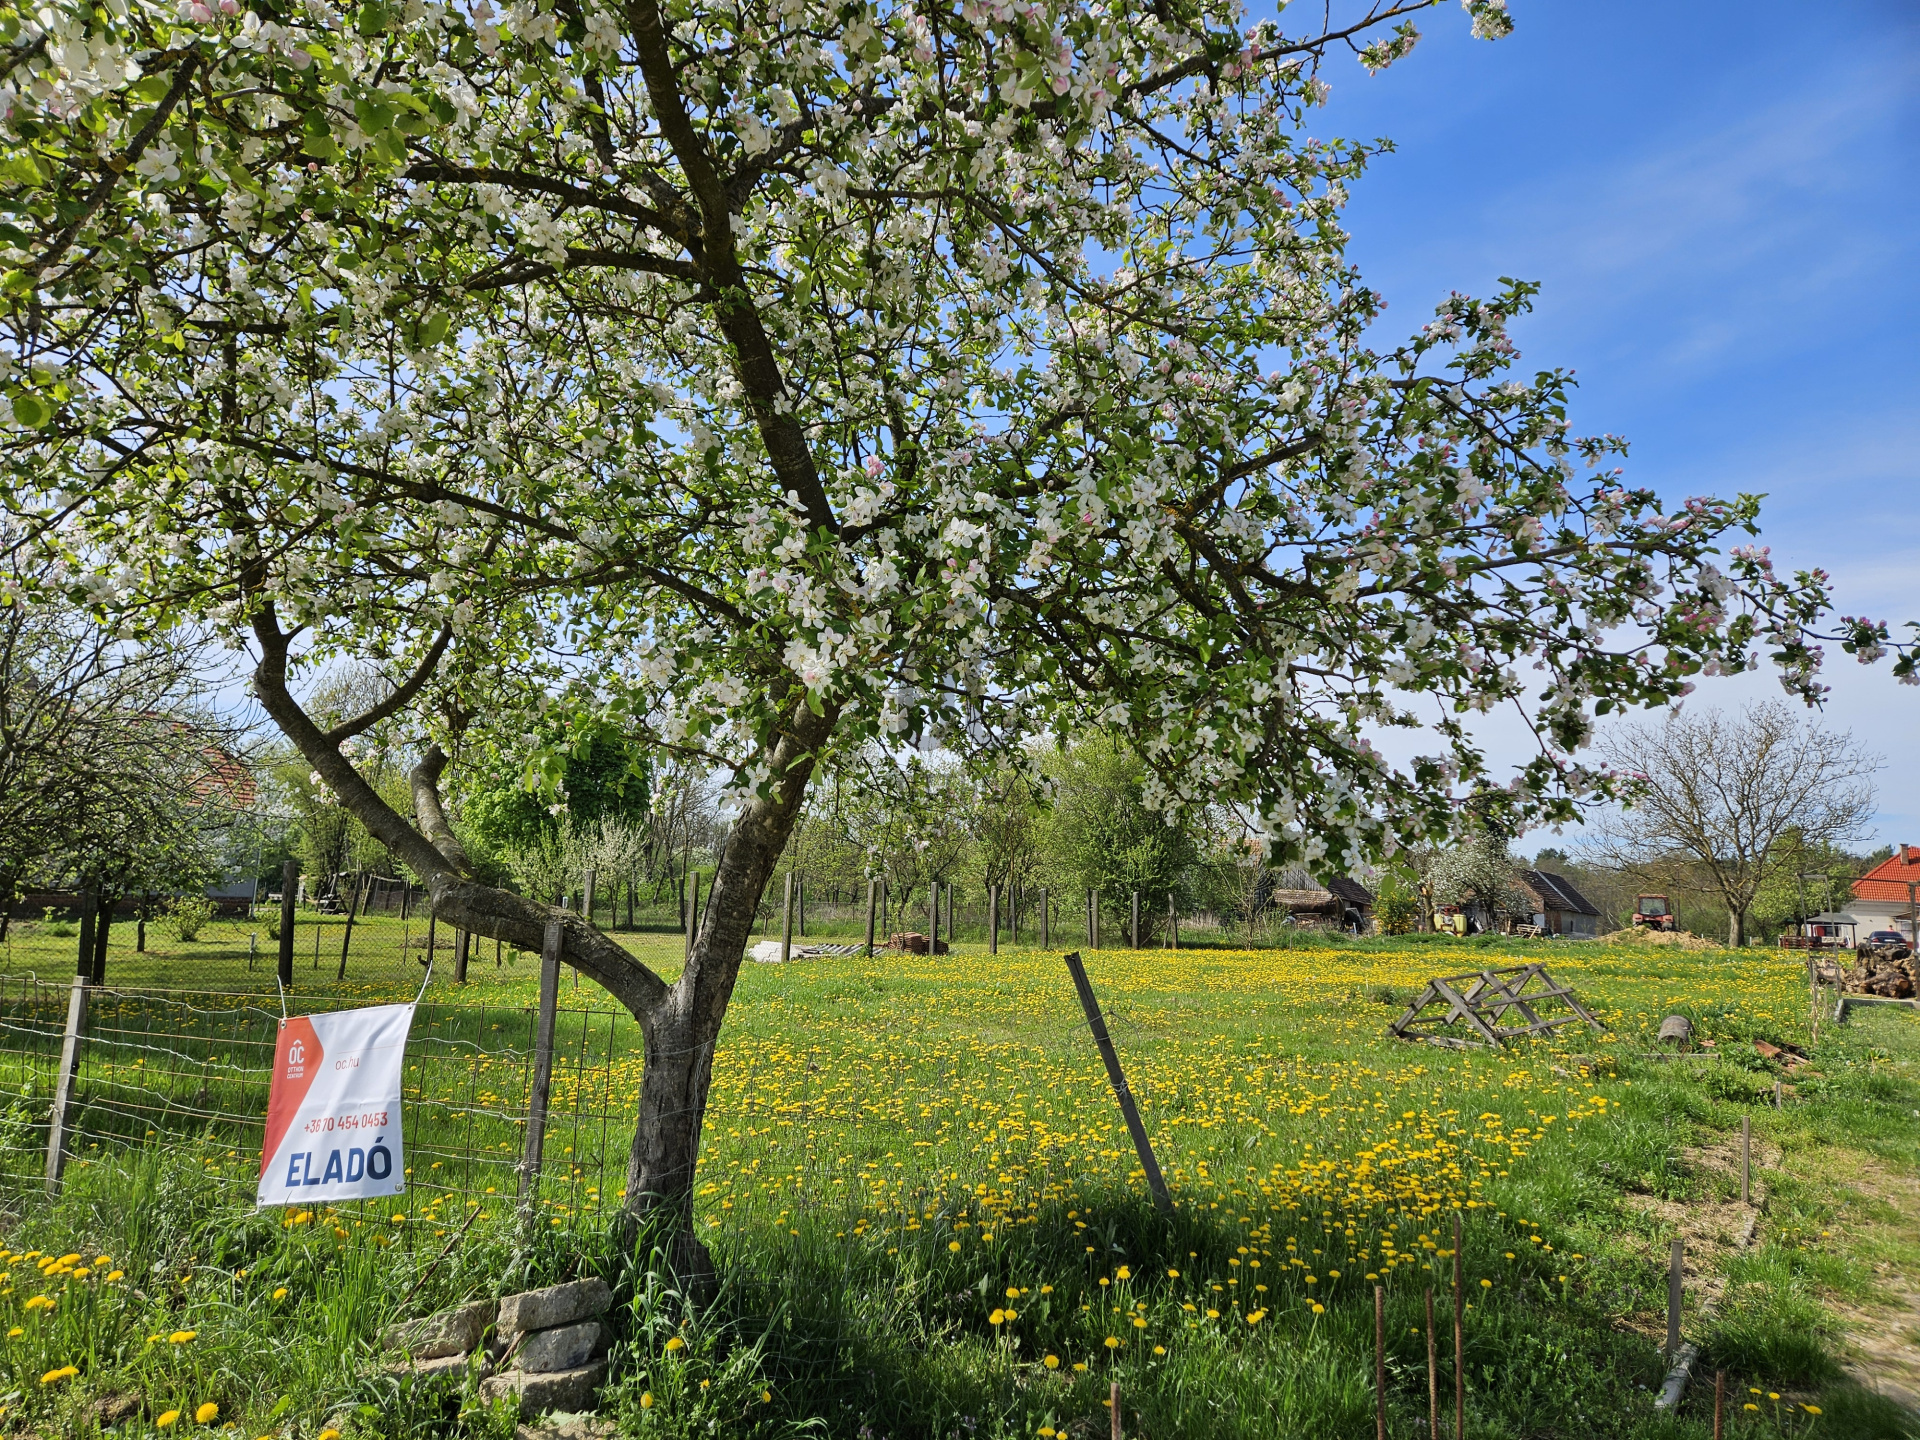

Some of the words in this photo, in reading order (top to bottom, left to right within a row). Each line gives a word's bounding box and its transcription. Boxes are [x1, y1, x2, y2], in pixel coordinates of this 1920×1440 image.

[335, 1056, 360, 1070] oc.hu
[337, 1115, 359, 1130] 454
[361, 1112, 388, 1128] 0453
[285, 1136, 392, 1187] ELADÓ
